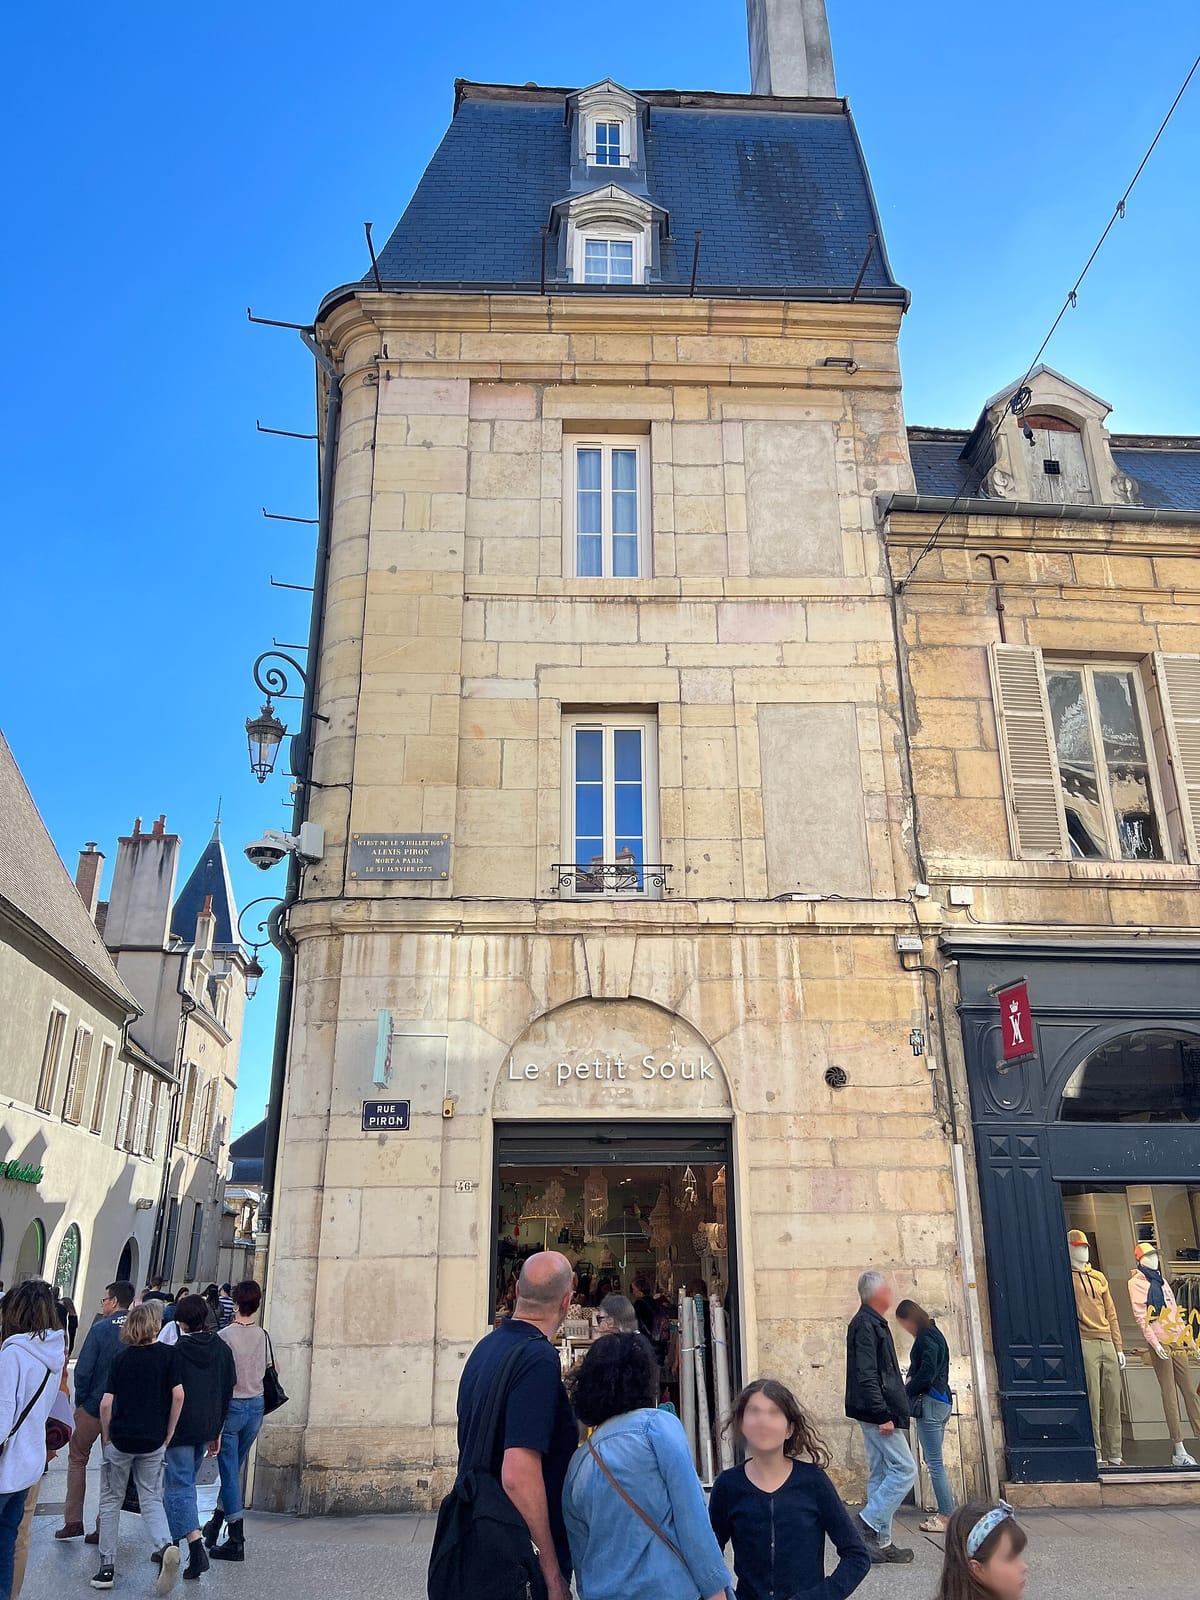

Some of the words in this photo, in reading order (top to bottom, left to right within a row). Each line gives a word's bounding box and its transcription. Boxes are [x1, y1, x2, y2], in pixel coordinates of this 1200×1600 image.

[508, 1056, 539, 1080] Le
[557, 1055, 626, 1087] petit
[641, 1055, 715, 1080] Souk
[376, 1105, 396, 1114] RUE
[369, 1116, 403, 1126] PIRON
